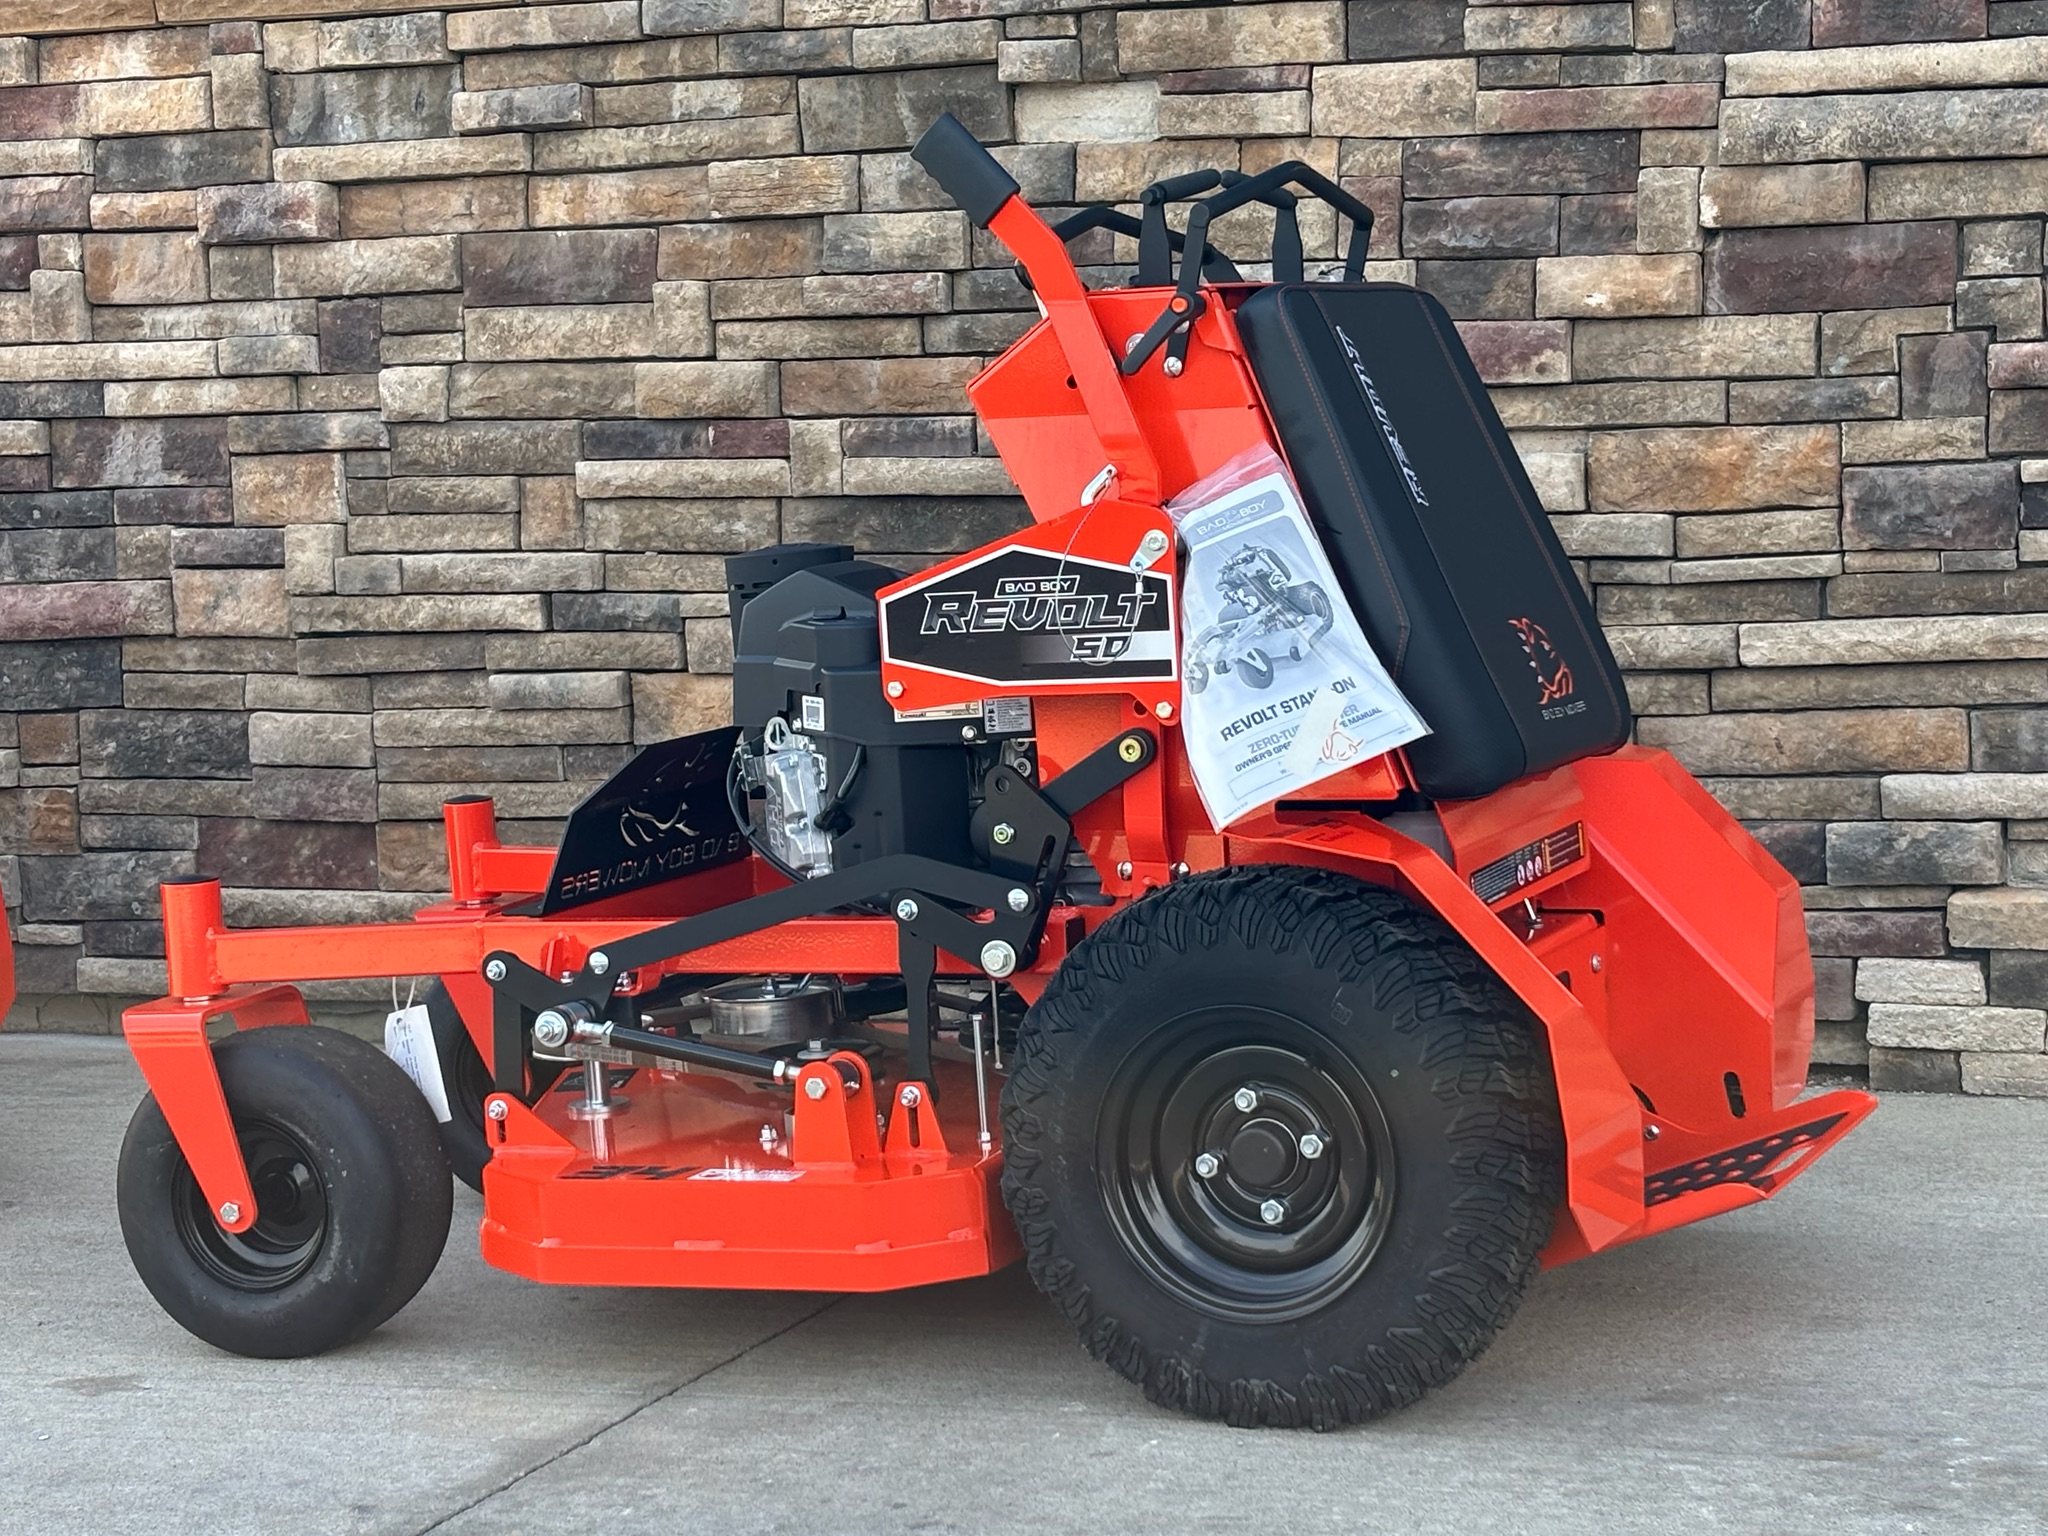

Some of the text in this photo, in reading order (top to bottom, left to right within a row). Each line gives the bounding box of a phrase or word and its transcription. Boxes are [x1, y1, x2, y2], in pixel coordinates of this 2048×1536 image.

[1196, 517, 1227, 536] BAD
[1239, 499, 1266, 517] BOY
[1005, 580, 1072, 593] BAD BOY
[920, 591, 1158, 635] REVOLT
[1220, 704, 1279, 742] REVOLT
[1235, 749, 1273, 773] OWNER'S
[1348, 706, 1383, 726] MANUAL
[1247, 724, 1300, 755] ZERO-TU
